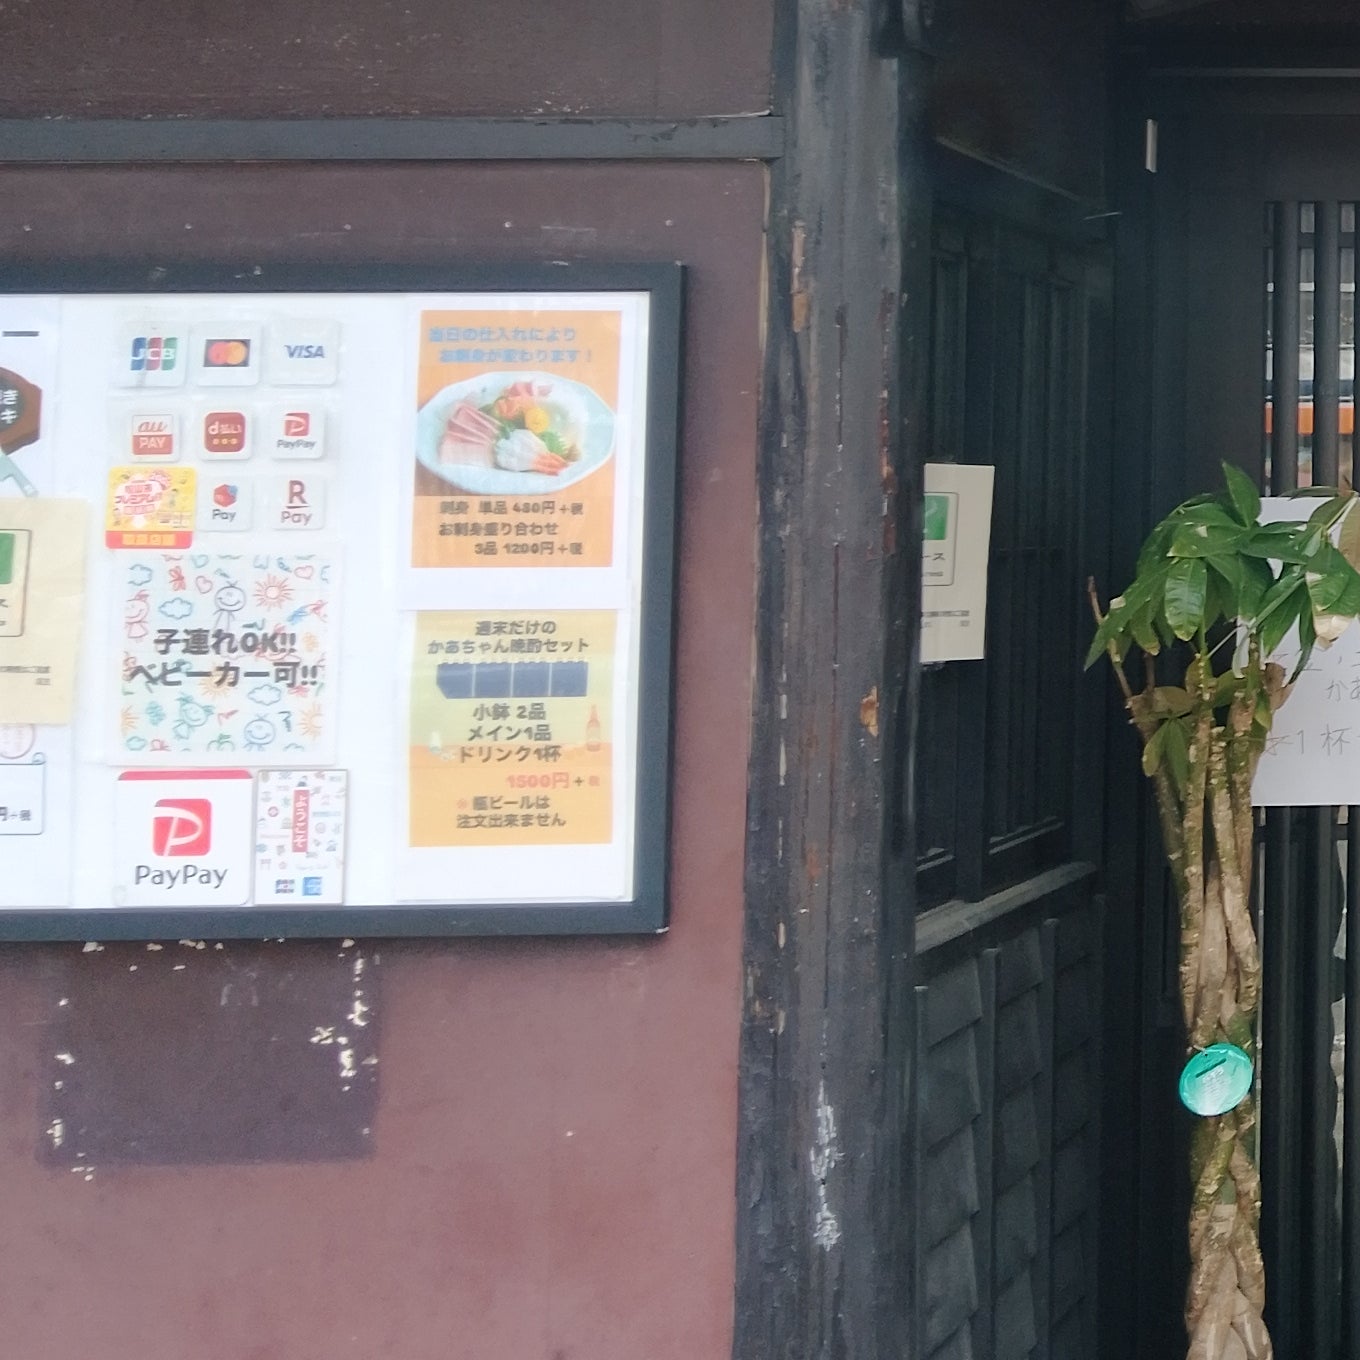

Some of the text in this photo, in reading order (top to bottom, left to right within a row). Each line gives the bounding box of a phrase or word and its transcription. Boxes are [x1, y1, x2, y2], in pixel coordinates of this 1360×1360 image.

[131, 341, 178, 367] JCB
[285, 344, 326, 359] VISA
[139, 437, 165, 449] PAY
[276, 439, 316, 450] PayPay
[211, 508, 237, 521] Pay
[280, 510, 312, 526] Pay
[154, 628, 298, 655] 子連れOK!!
[516, 703, 547, 720] 2品
[468, 724, 553, 741] メイン1品
[458, 746, 562, 763] ドリンク1杯
[455, 813, 566, 829] 注文出来ません
[134, 864, 228, 890] PayPay
